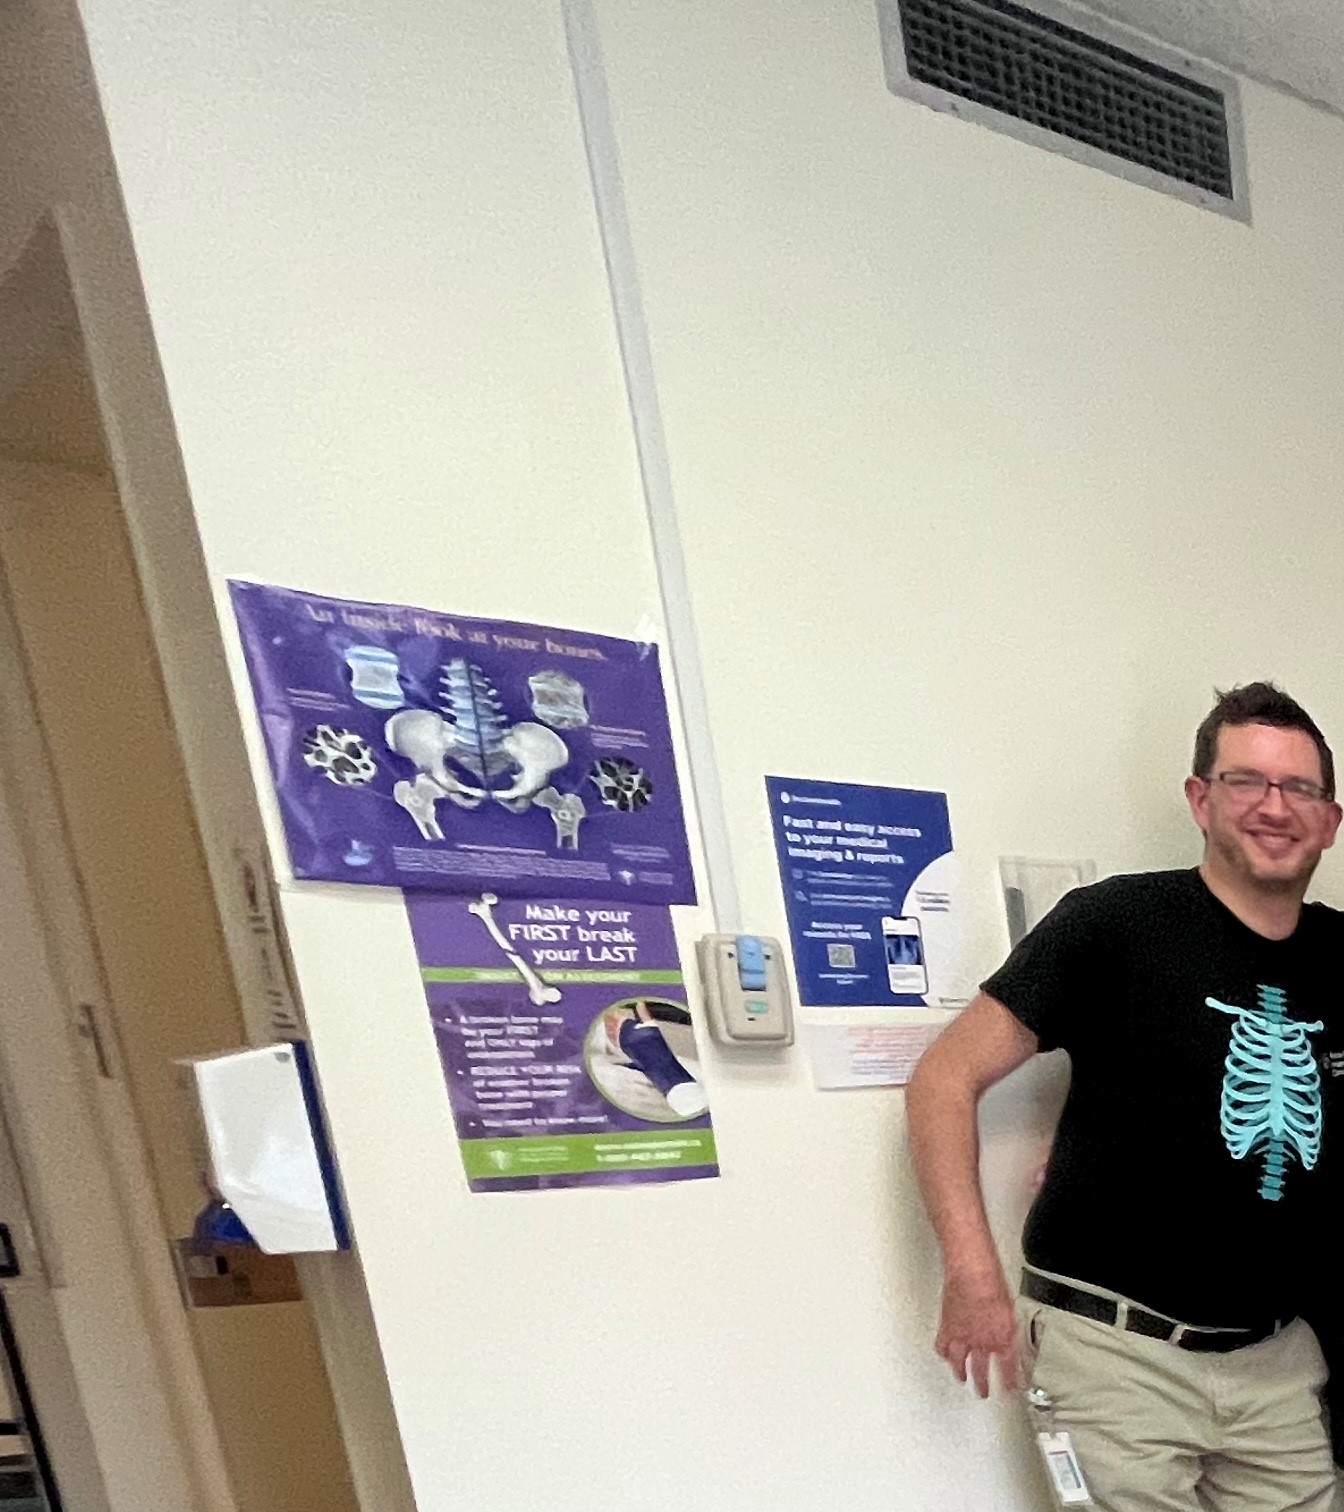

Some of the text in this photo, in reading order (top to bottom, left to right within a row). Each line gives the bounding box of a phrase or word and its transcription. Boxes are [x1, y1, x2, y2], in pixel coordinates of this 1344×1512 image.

[816, 820, 842, 831] and
[803, 833, 834, 845] your
[525, 904, 632, 926] Make your
[508, 923, 636, 943] FIRST break
[532, 946, 638, 965] your LAST
